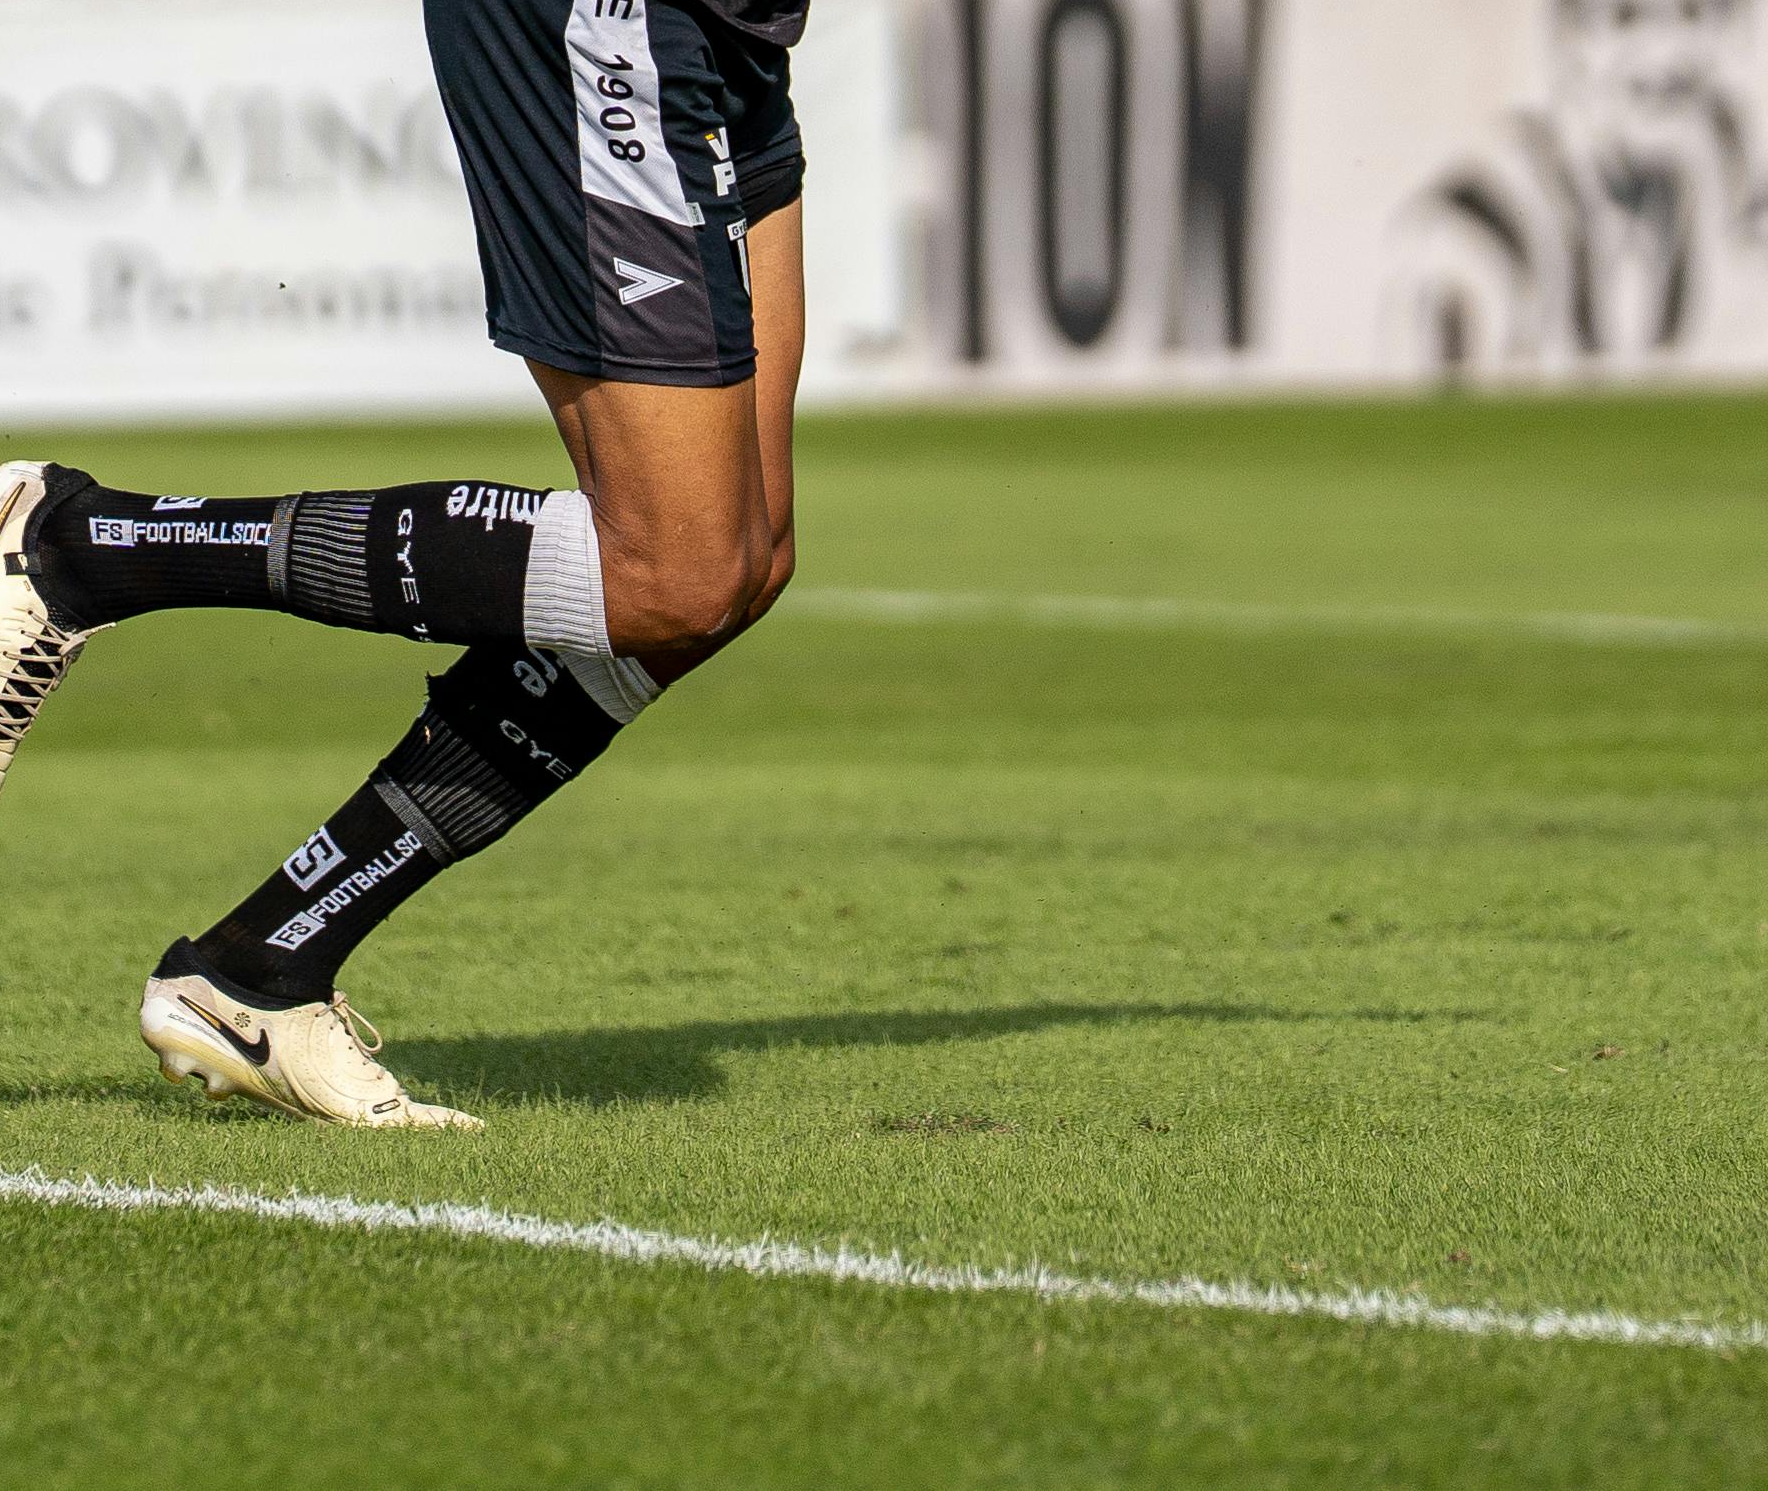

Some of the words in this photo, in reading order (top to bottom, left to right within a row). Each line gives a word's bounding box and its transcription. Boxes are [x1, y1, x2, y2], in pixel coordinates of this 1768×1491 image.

[594, 54, 646, 163] 1908
[446, 485, 539, 532] mitre
[397, 509, 420, 604] GYE
[499, 719, 573, 780] GYE
